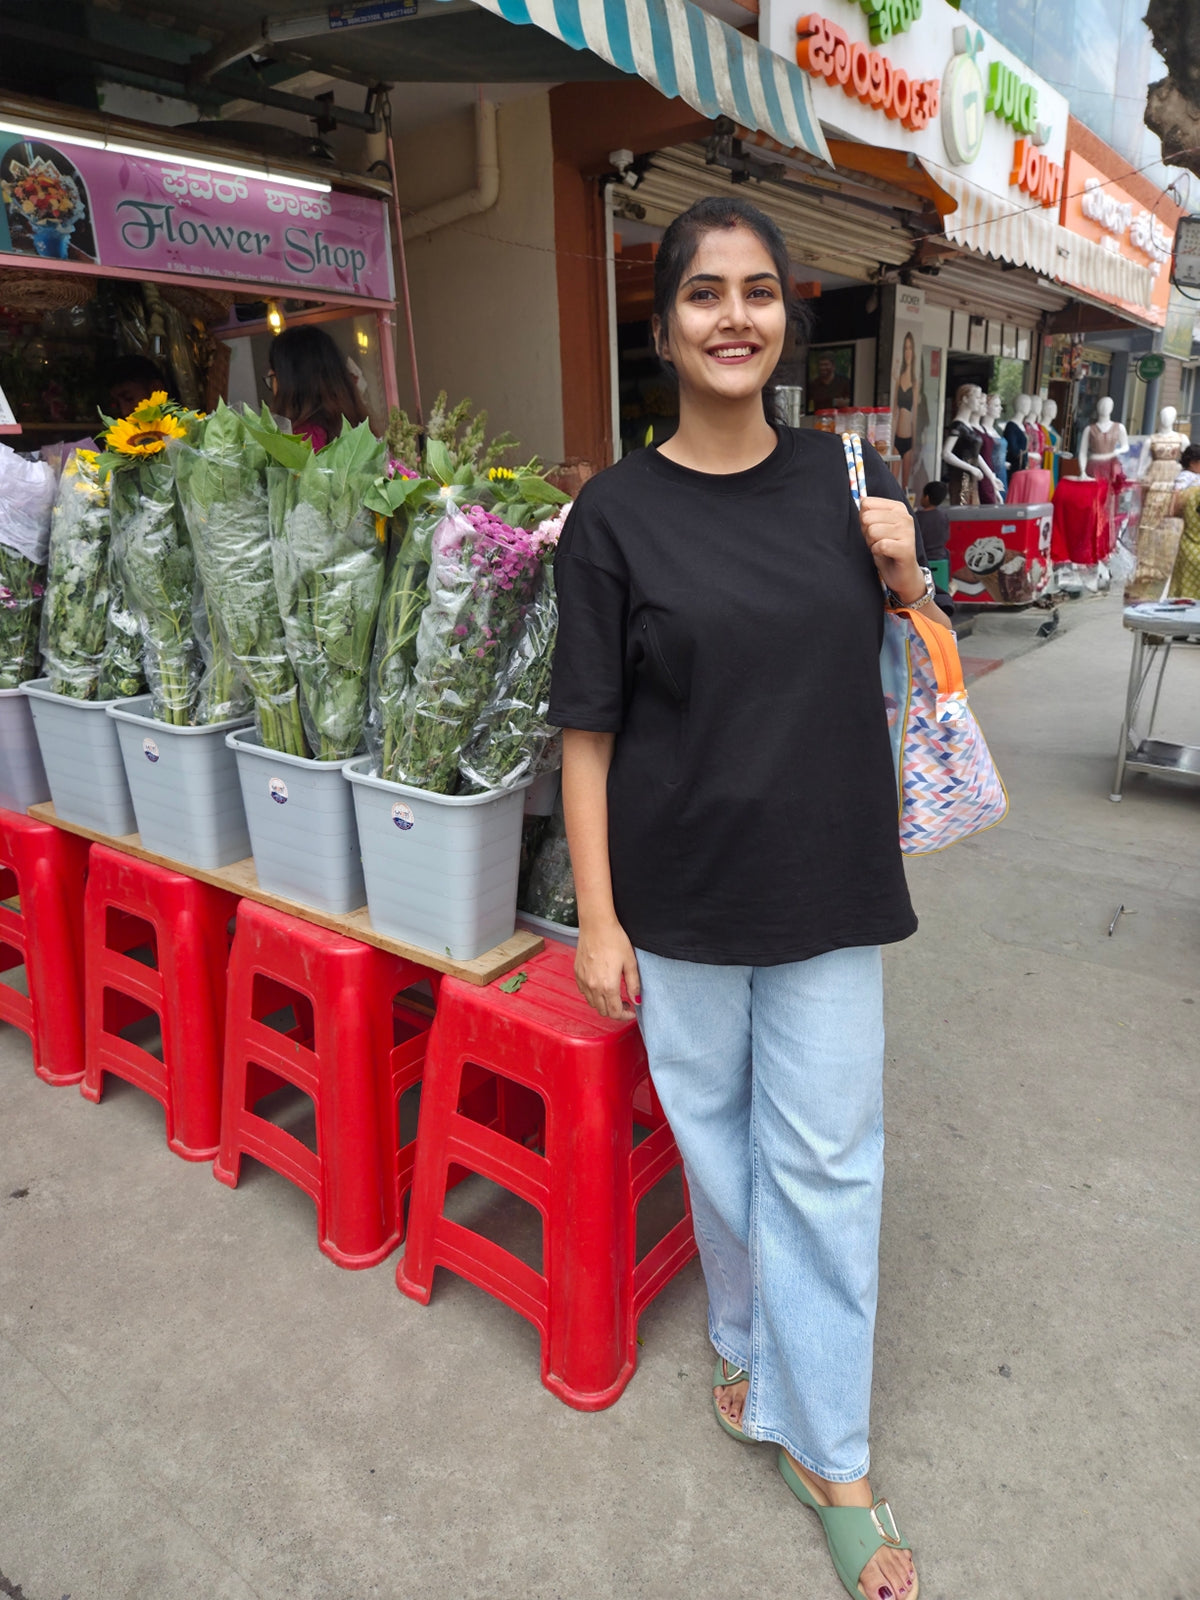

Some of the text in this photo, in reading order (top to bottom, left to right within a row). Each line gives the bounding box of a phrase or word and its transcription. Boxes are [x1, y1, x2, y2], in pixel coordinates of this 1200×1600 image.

[986, 61, 1038, 135] JUICE
[161, 166, 332, 220] ಫ್ಲವರ್ ಶಾಪ್
[1009, 139, 1065, 208] JOINT
[116, 200, 366, 282] Flower Shop
